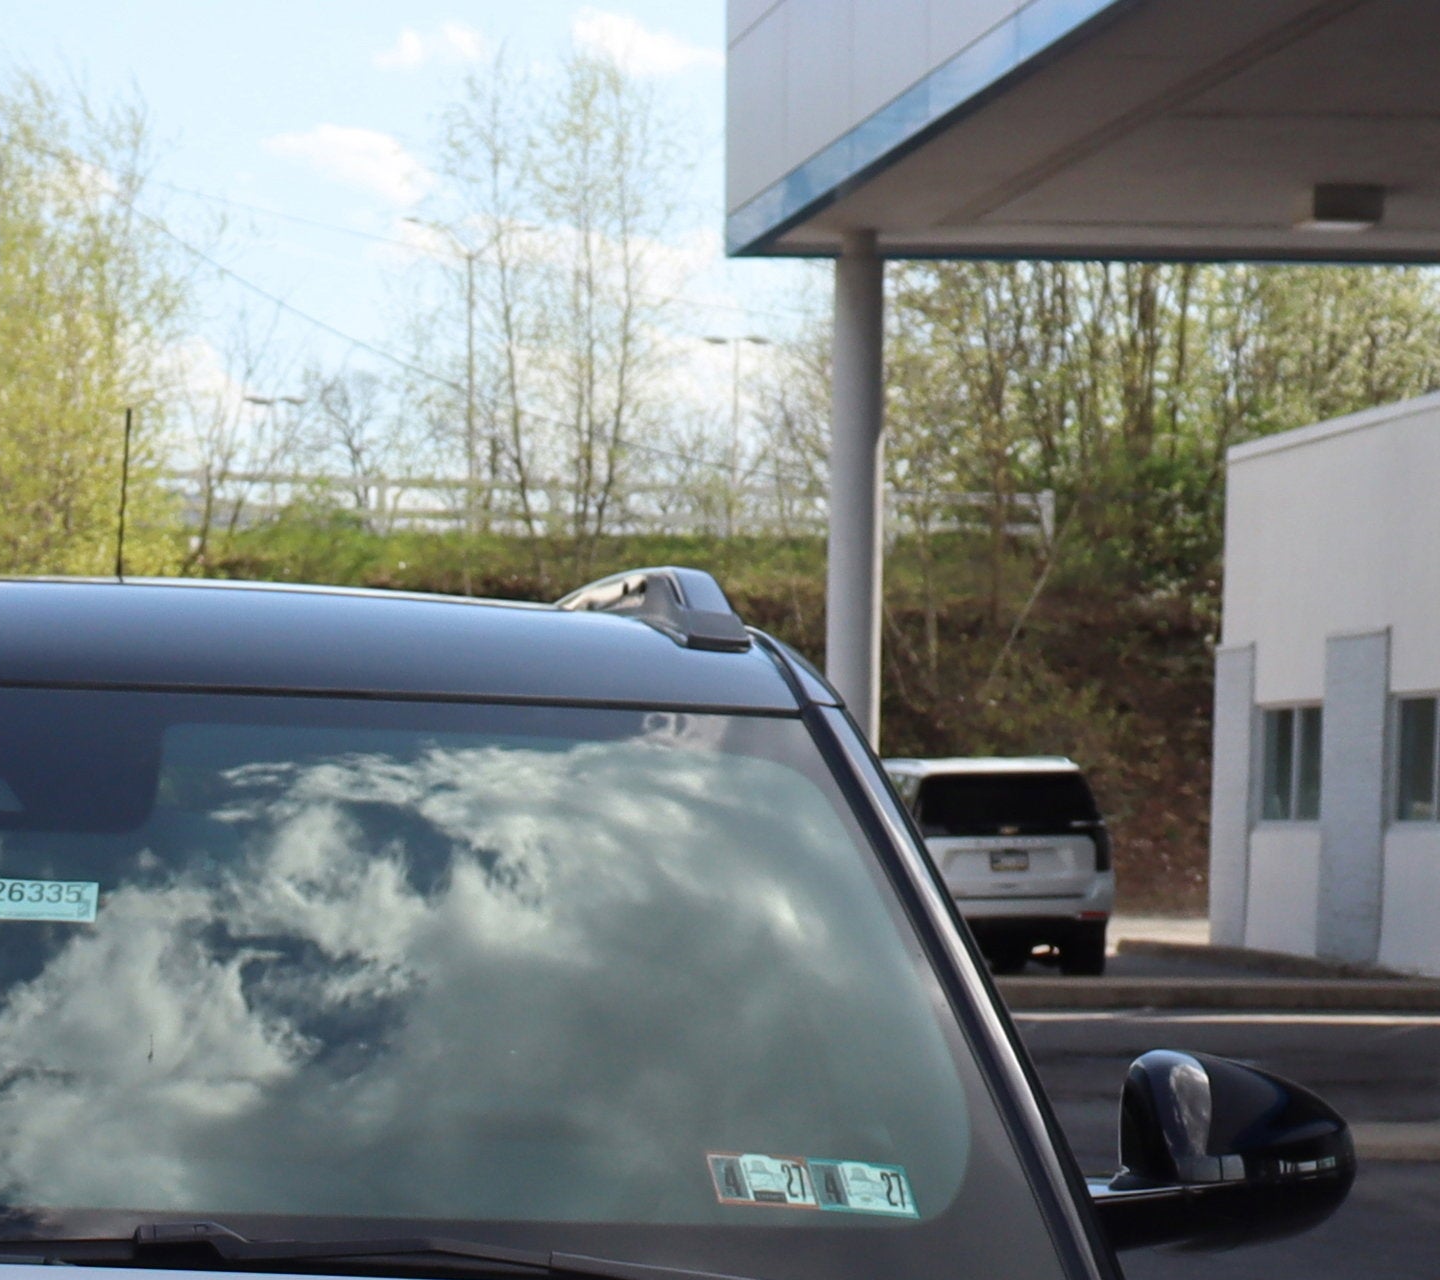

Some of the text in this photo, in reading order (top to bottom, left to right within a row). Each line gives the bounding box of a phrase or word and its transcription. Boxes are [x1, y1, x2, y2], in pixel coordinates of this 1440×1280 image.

[724, 1163, 806, 1201] 4 27
[824, 1170, 906, 1209] 4 27
